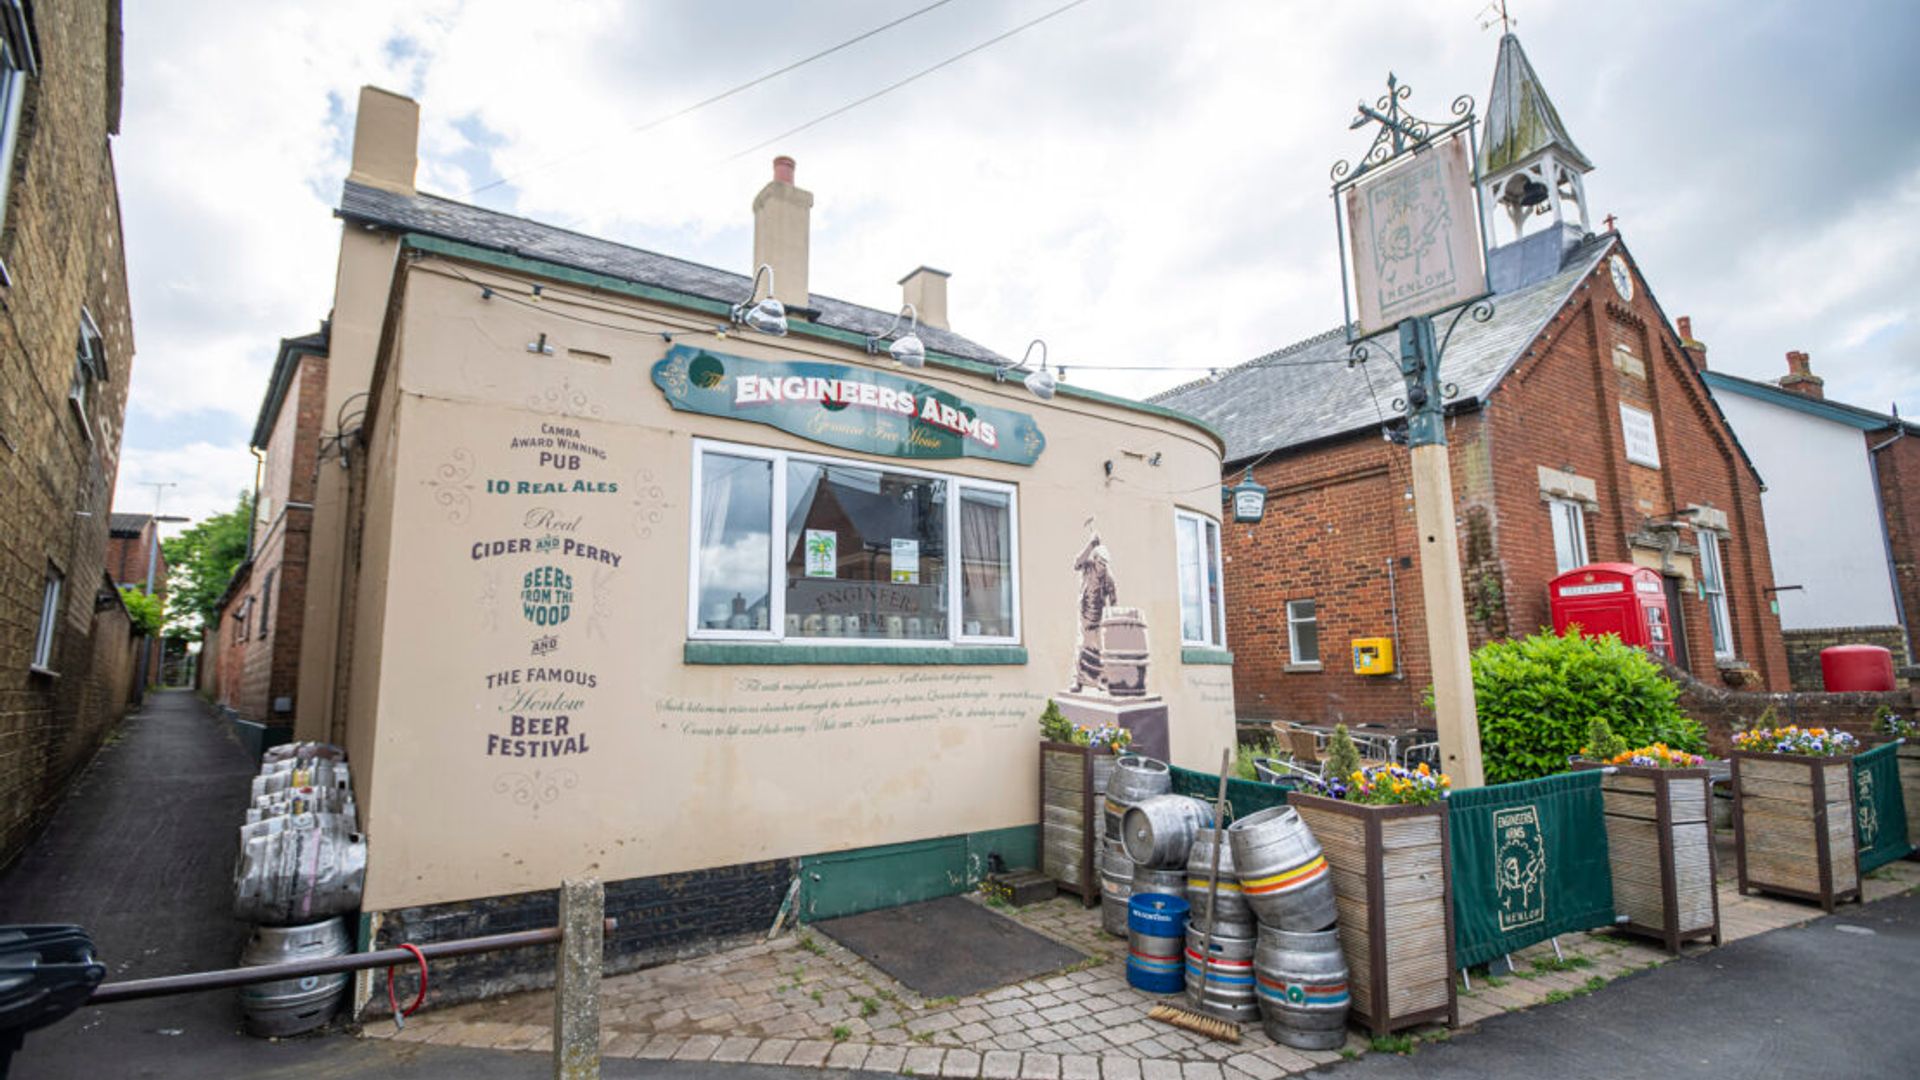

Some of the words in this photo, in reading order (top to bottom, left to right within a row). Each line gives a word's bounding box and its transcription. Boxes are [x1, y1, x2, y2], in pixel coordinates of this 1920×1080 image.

[1388, 269, 1447, 299] HENLOW
[734, 374, 916, 416] ENGINEERS
[921, 396, 999, 446] ARMS
[541, 423, 580, 438] CAMRA
[511, 437, 553, 449] AWARD
[557, 436, 607, 460] WINNING
[539, 452, 581, 471] PUB
[486, 479, 510, 494] 10
[517, 481, 567, 494] REAL
[572, 480, 618, 493] ALES
[523, 507, 583, 532] Real
[471, 538, 531, 560] CIDER
[536, 537, 560, 549] AND
[563, 538, 622, 567] PERRY
[523, 566, 573, 590] BEERS
[521, 589, 551, 604] FROM
[555, 590, 574, 604] THE
[523, 602, 570, 626] WOOD
[532, 638, 558, 652] AND
[485, 669, 521, 689] THE
[527, 668, 597, 688] FAMOUS
[498, 689, 585, 713] Henlow
[510, 715, 570, 736] BEER
[487, 733, 589, 758] FESTIVAL
